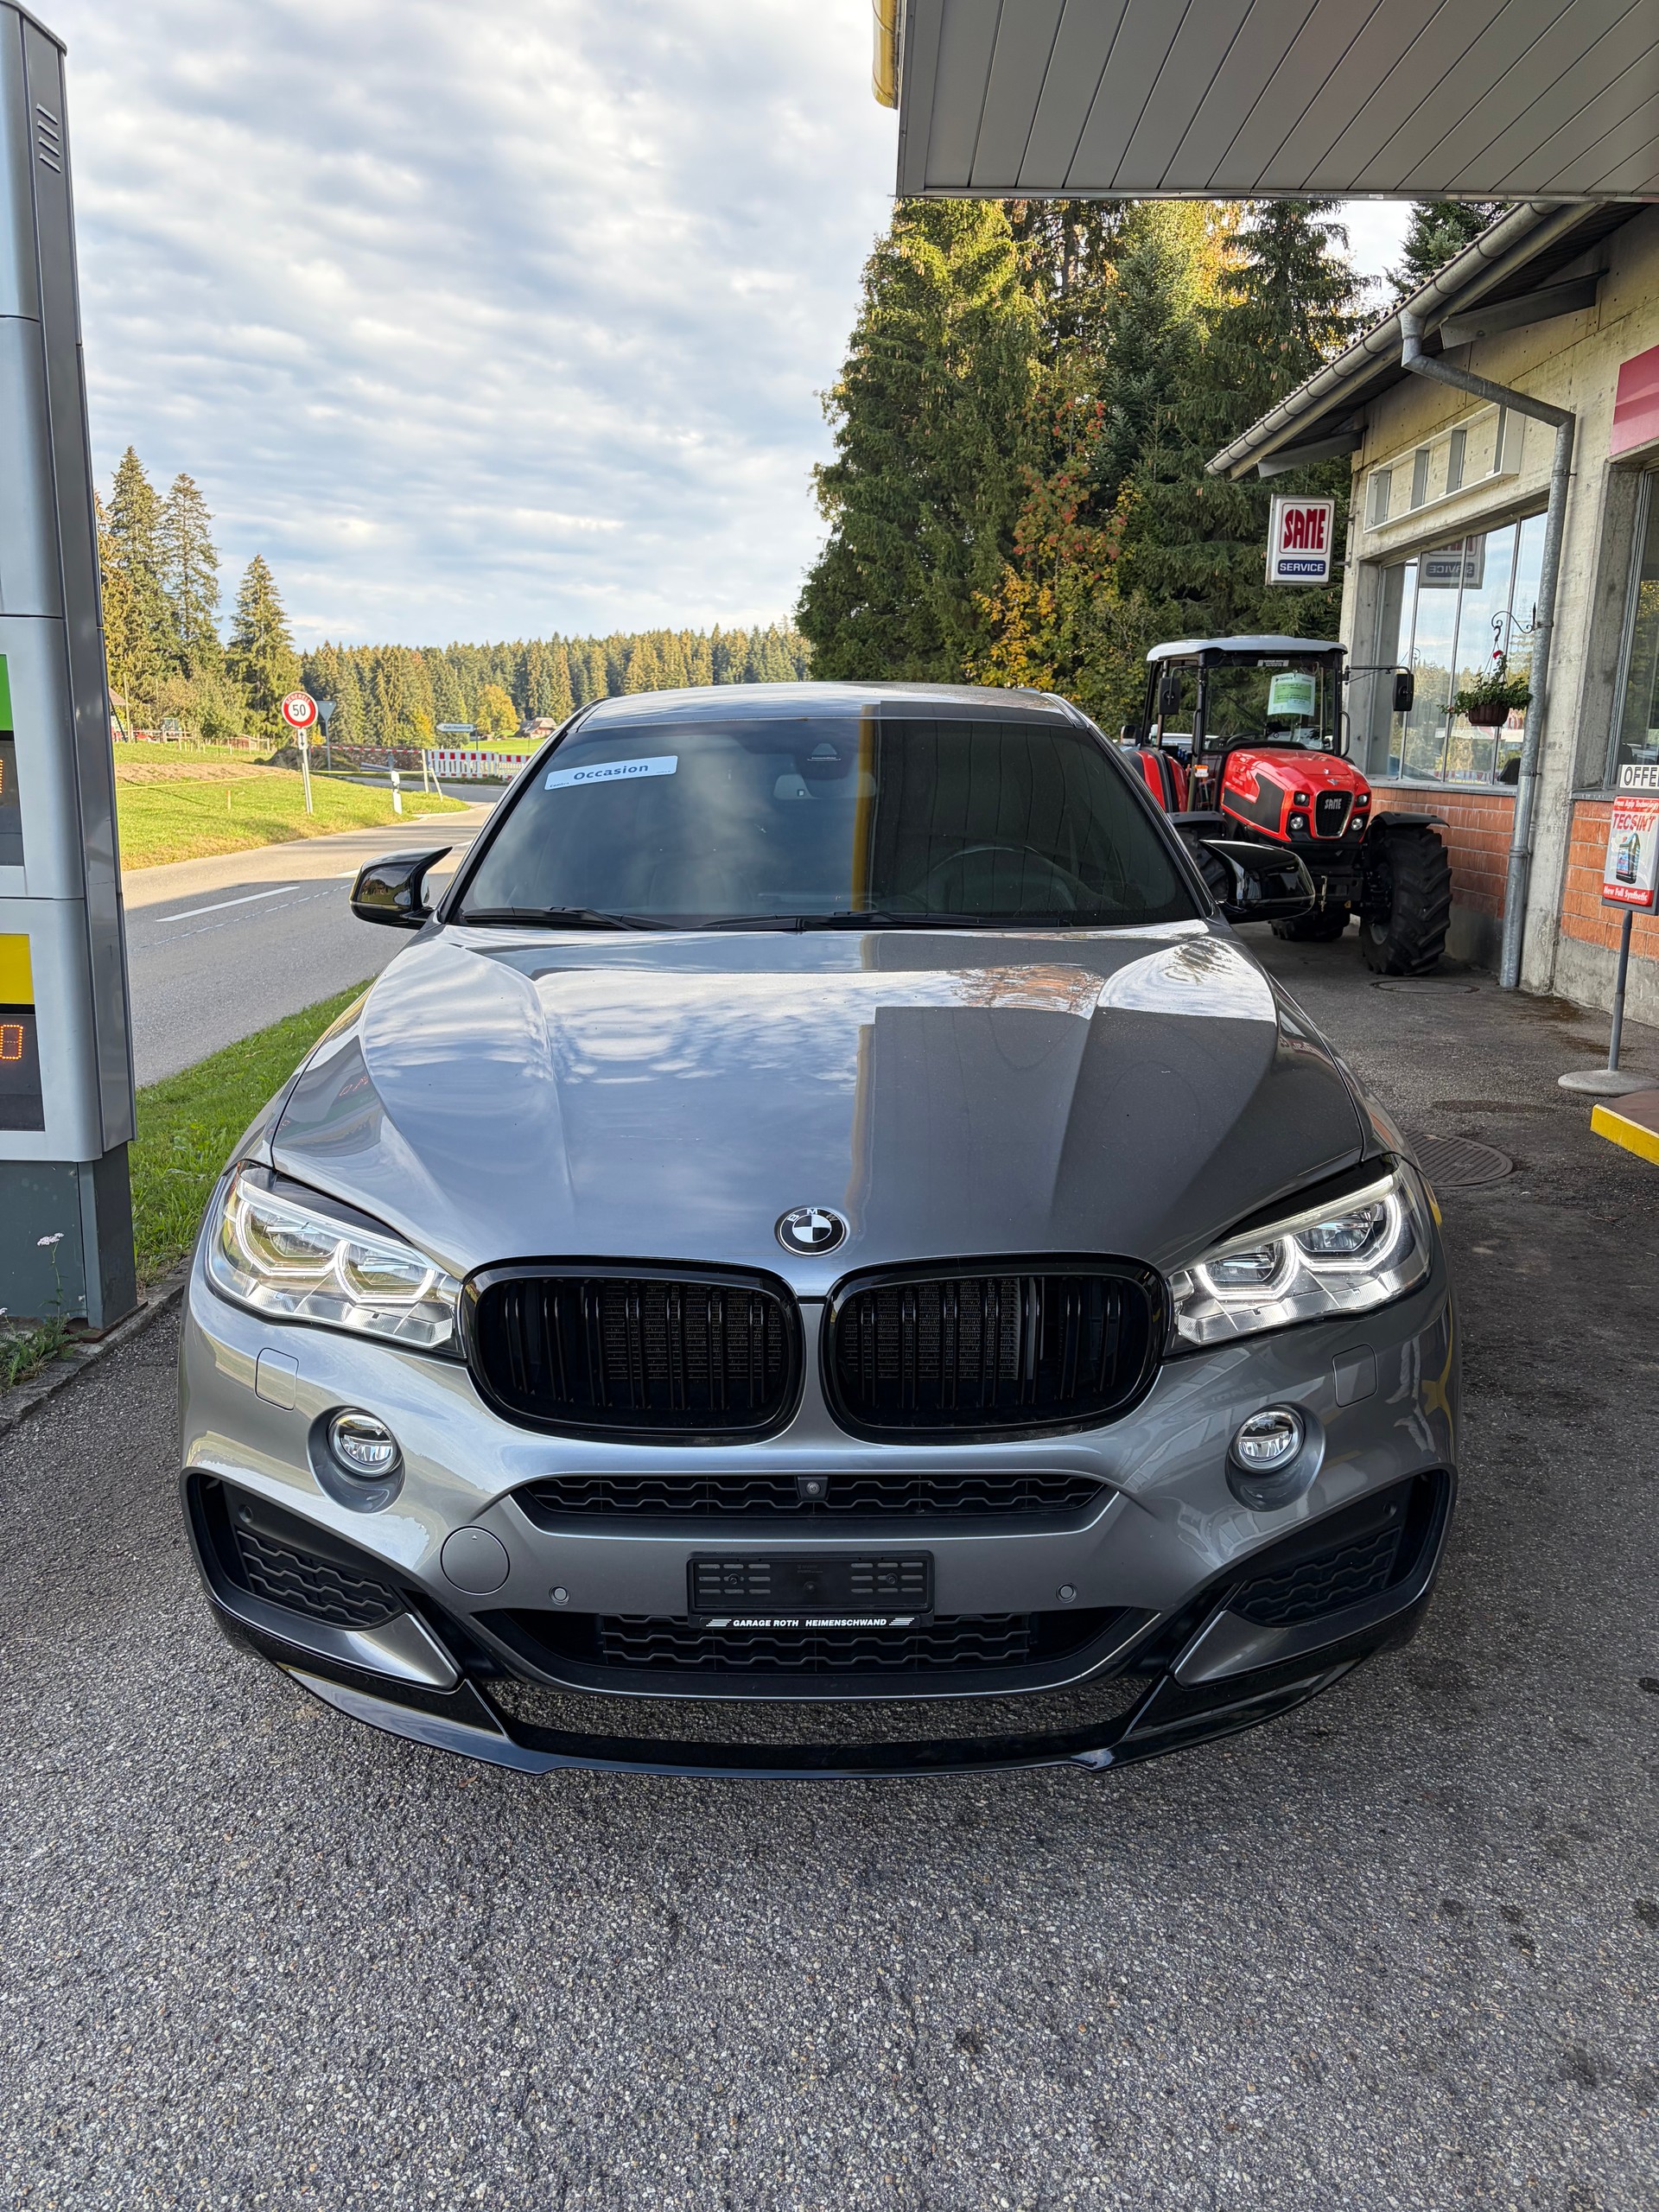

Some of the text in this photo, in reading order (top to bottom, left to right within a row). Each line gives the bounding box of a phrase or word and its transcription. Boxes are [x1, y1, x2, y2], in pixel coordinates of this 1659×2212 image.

[1283, 508, 1326, 550] SAME
[1280, 563, 1325, 572] SERVICE
[292, 703, 307, 716] 50
[573, 765, 649, 780] Occasion
[1624, 766, 1659, 787] OFFE
[1324, 798, 1343, 810] SAME
[1612, 813, 1656, 832] TECSINT
[1604, 886, 1649, 901] New Full Synthetic
[786, 1208, 838, 1223] BMW
[805, 1618, 887, 1628] HEIMENSCHWAND
